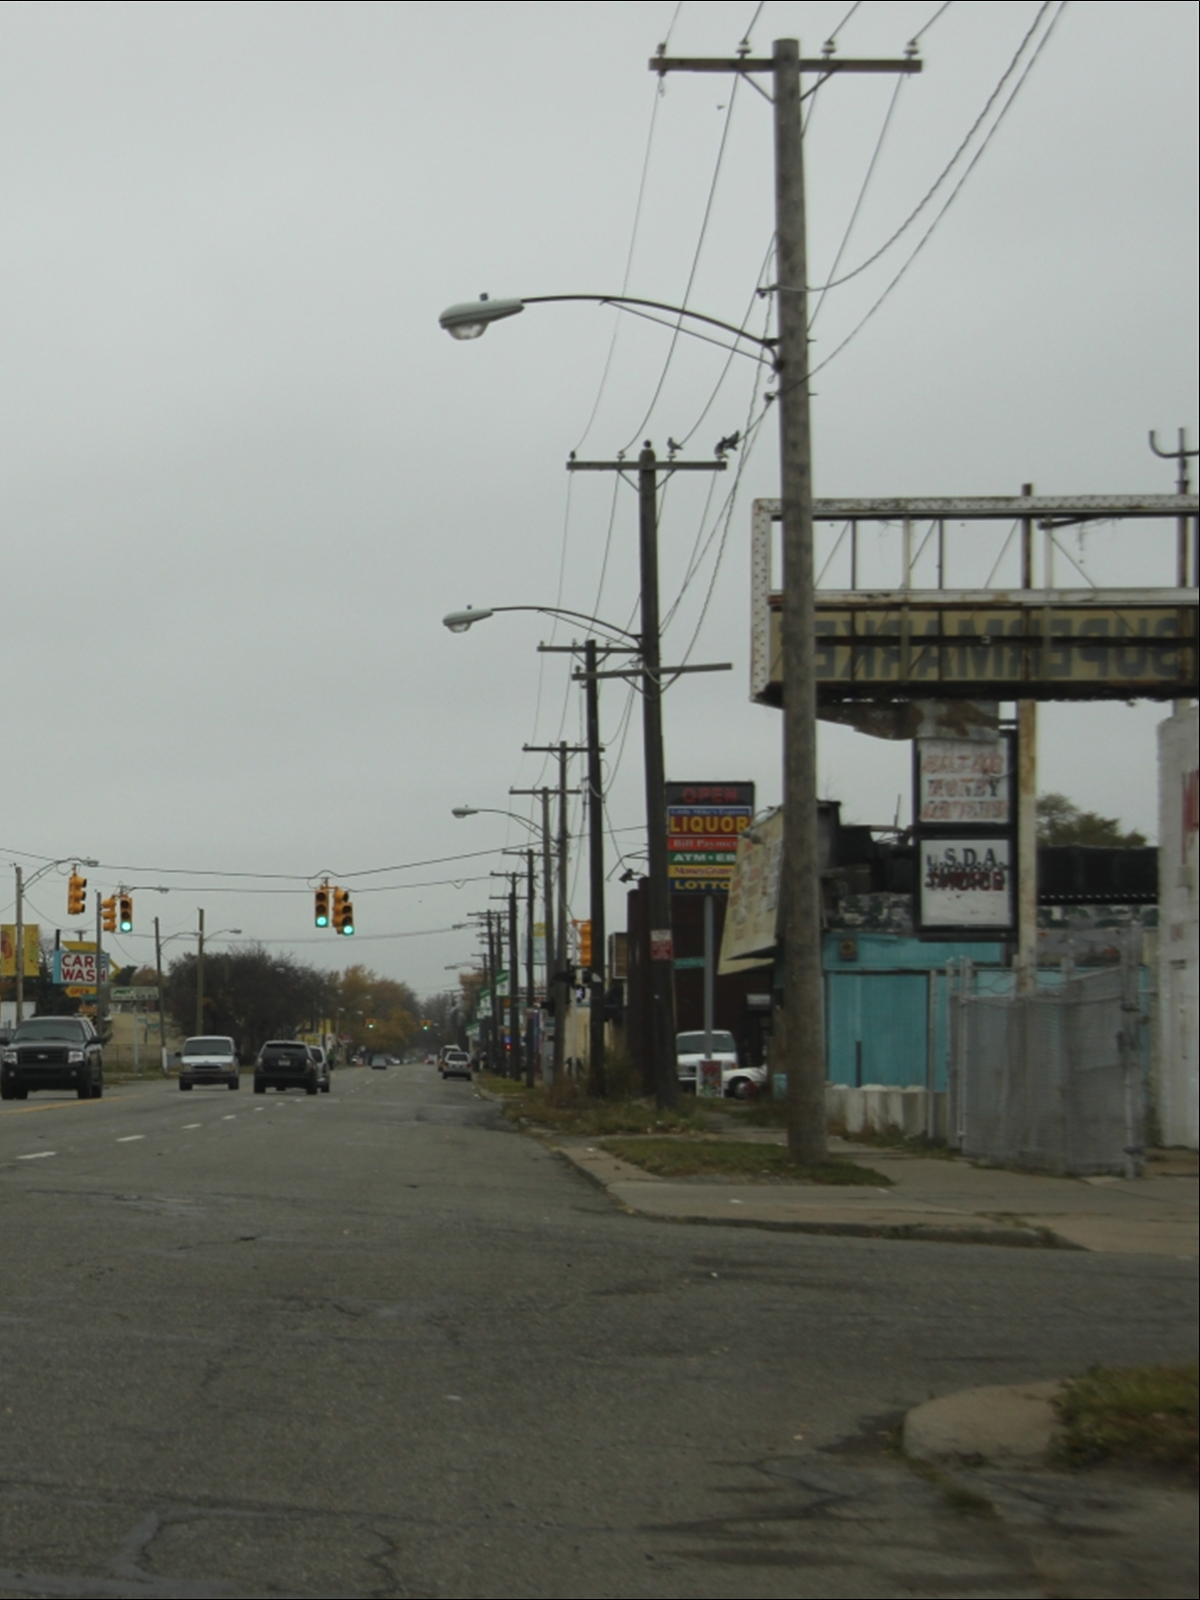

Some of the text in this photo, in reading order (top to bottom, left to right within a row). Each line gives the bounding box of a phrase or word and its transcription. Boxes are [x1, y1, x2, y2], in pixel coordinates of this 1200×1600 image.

[682, 787, 739, 804] OPEN
[670, 816, 749, 832] LIQUOR
[673, 853, 706, 862] ATM
[926, 848, 1005, 867] U.S.D.A.
[675, 881, 730, 890] LOTTO
[62, 954, 94, 968] CAR
[62, 969, 106, 982] WASH
